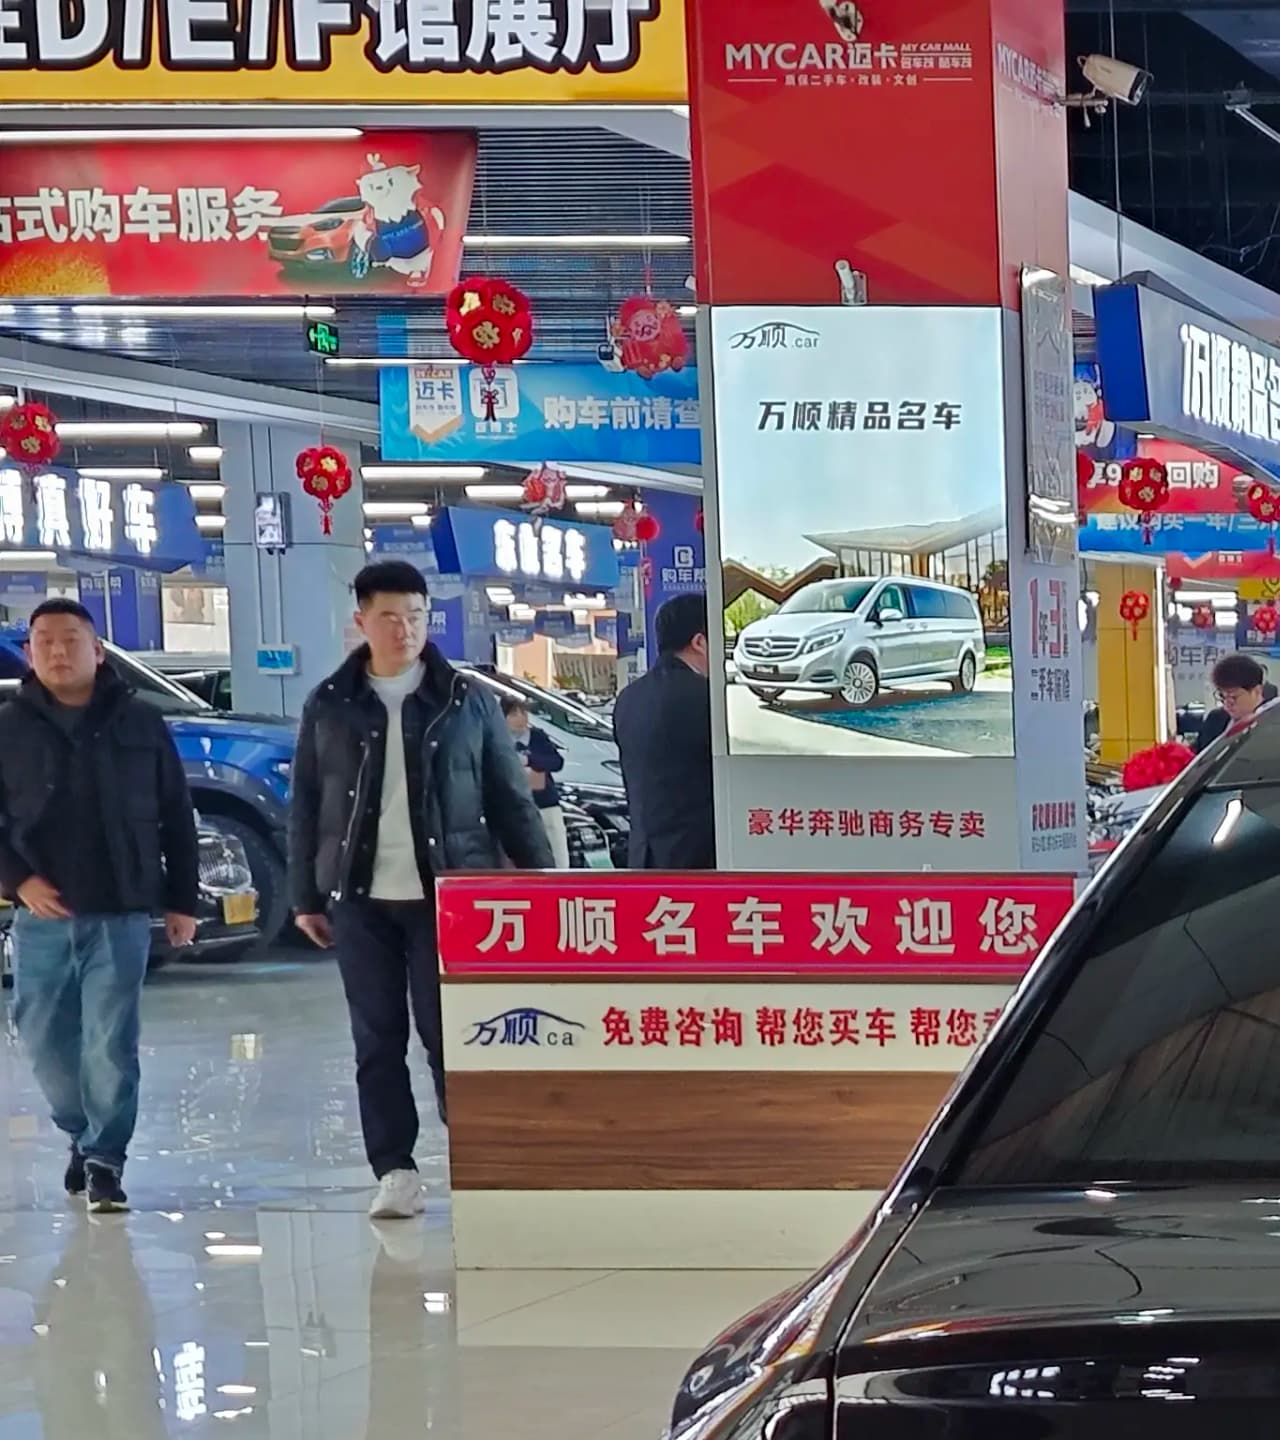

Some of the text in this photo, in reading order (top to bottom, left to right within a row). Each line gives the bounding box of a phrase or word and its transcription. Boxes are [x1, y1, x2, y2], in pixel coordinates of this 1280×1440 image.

[0, 186, 285, 244] 式购车服务
[415, 381, 454, 401] 迈卡
[543, 396, 700, 430] 购车前请查
[757, 400, 962, 431] 万顺精品名车
[748, 808, 987, 838] 豪华奔驰商务专卖
[473, 896, 1038, 956] 万顺名车欢迎您
[602, 1006, 743, 1047] 免费咨询
[756, 1007, 896, 1047] 帮您买车
